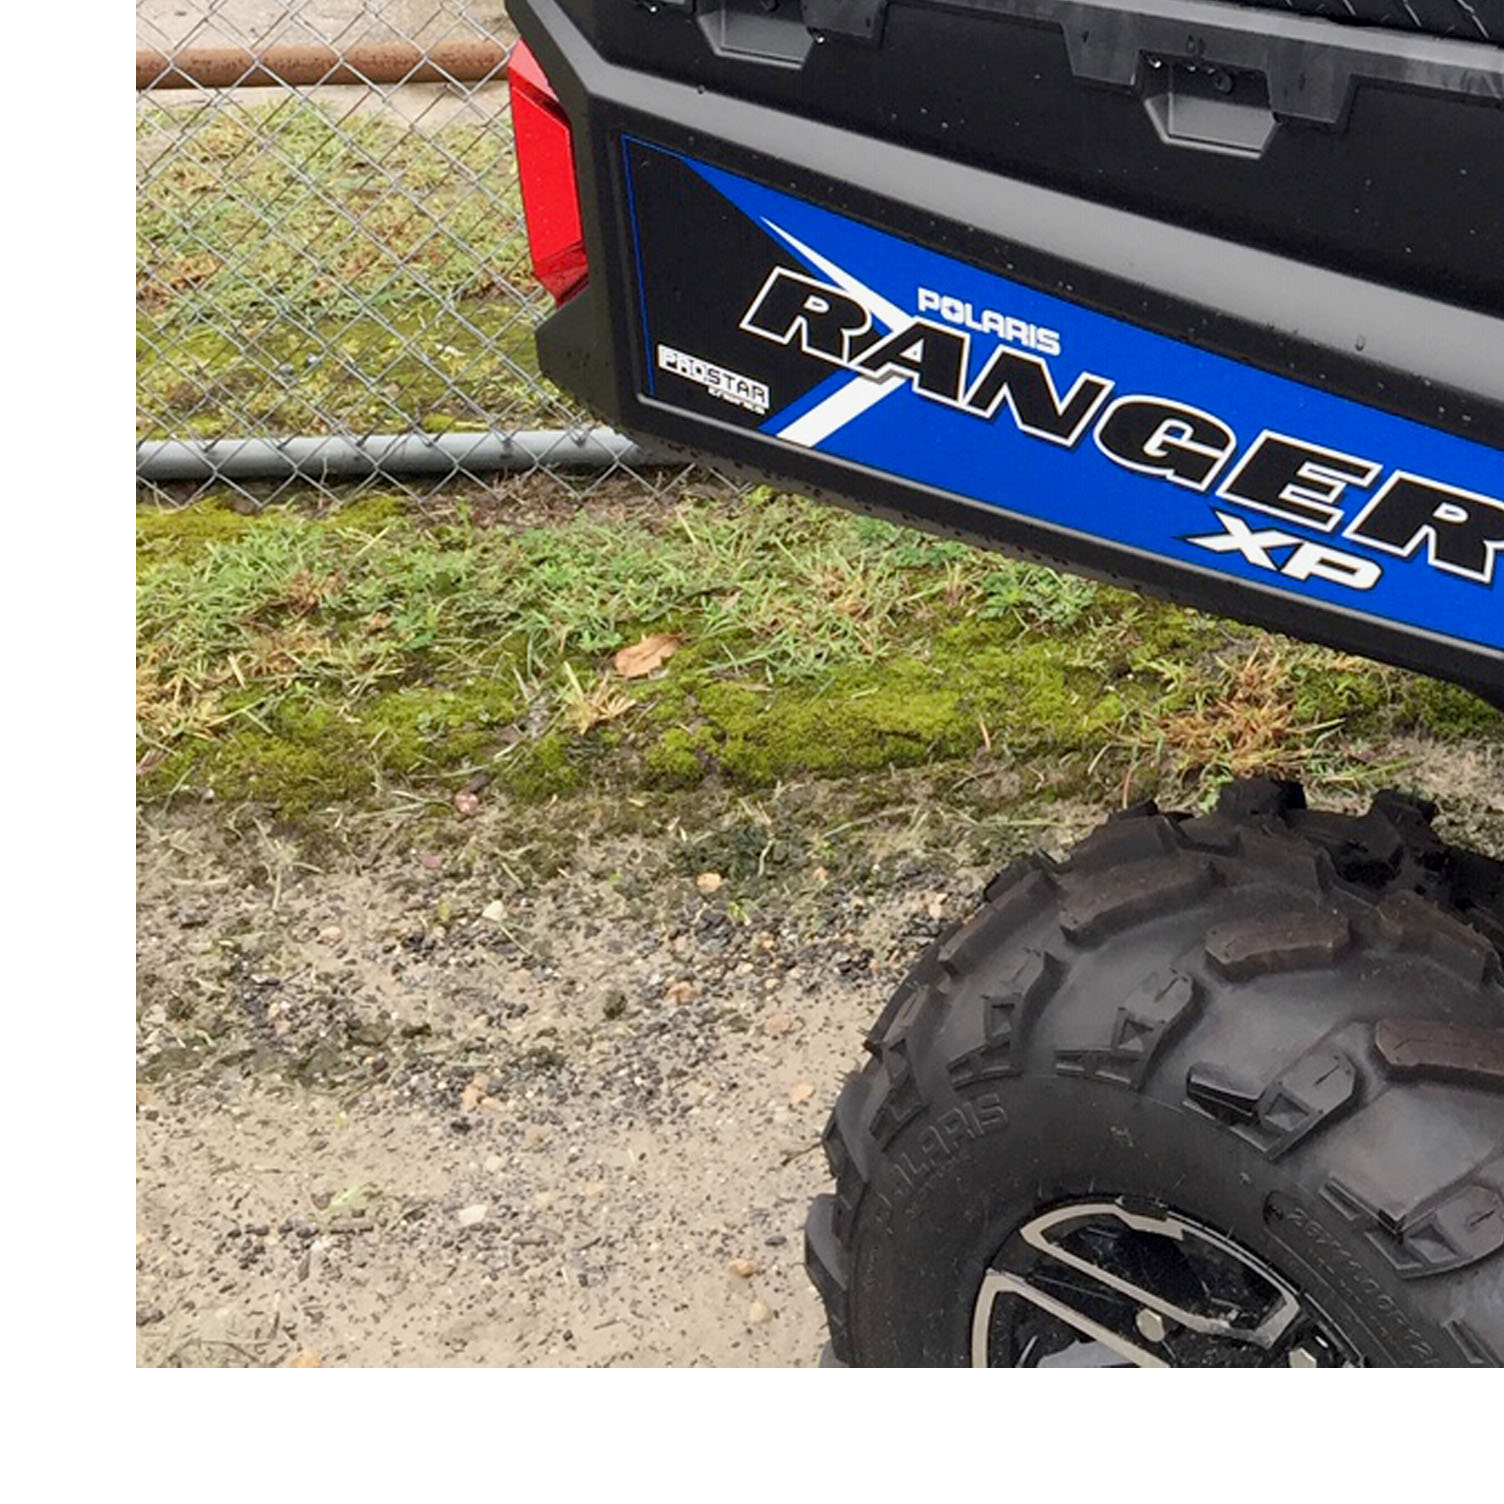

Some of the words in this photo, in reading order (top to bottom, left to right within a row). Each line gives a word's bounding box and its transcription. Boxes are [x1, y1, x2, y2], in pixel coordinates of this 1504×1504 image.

[918, 287, 1061, 356] POLARIS
[659, 344, 769, 407] PROSTAR
[1187, 510, 1382, 590] XP
